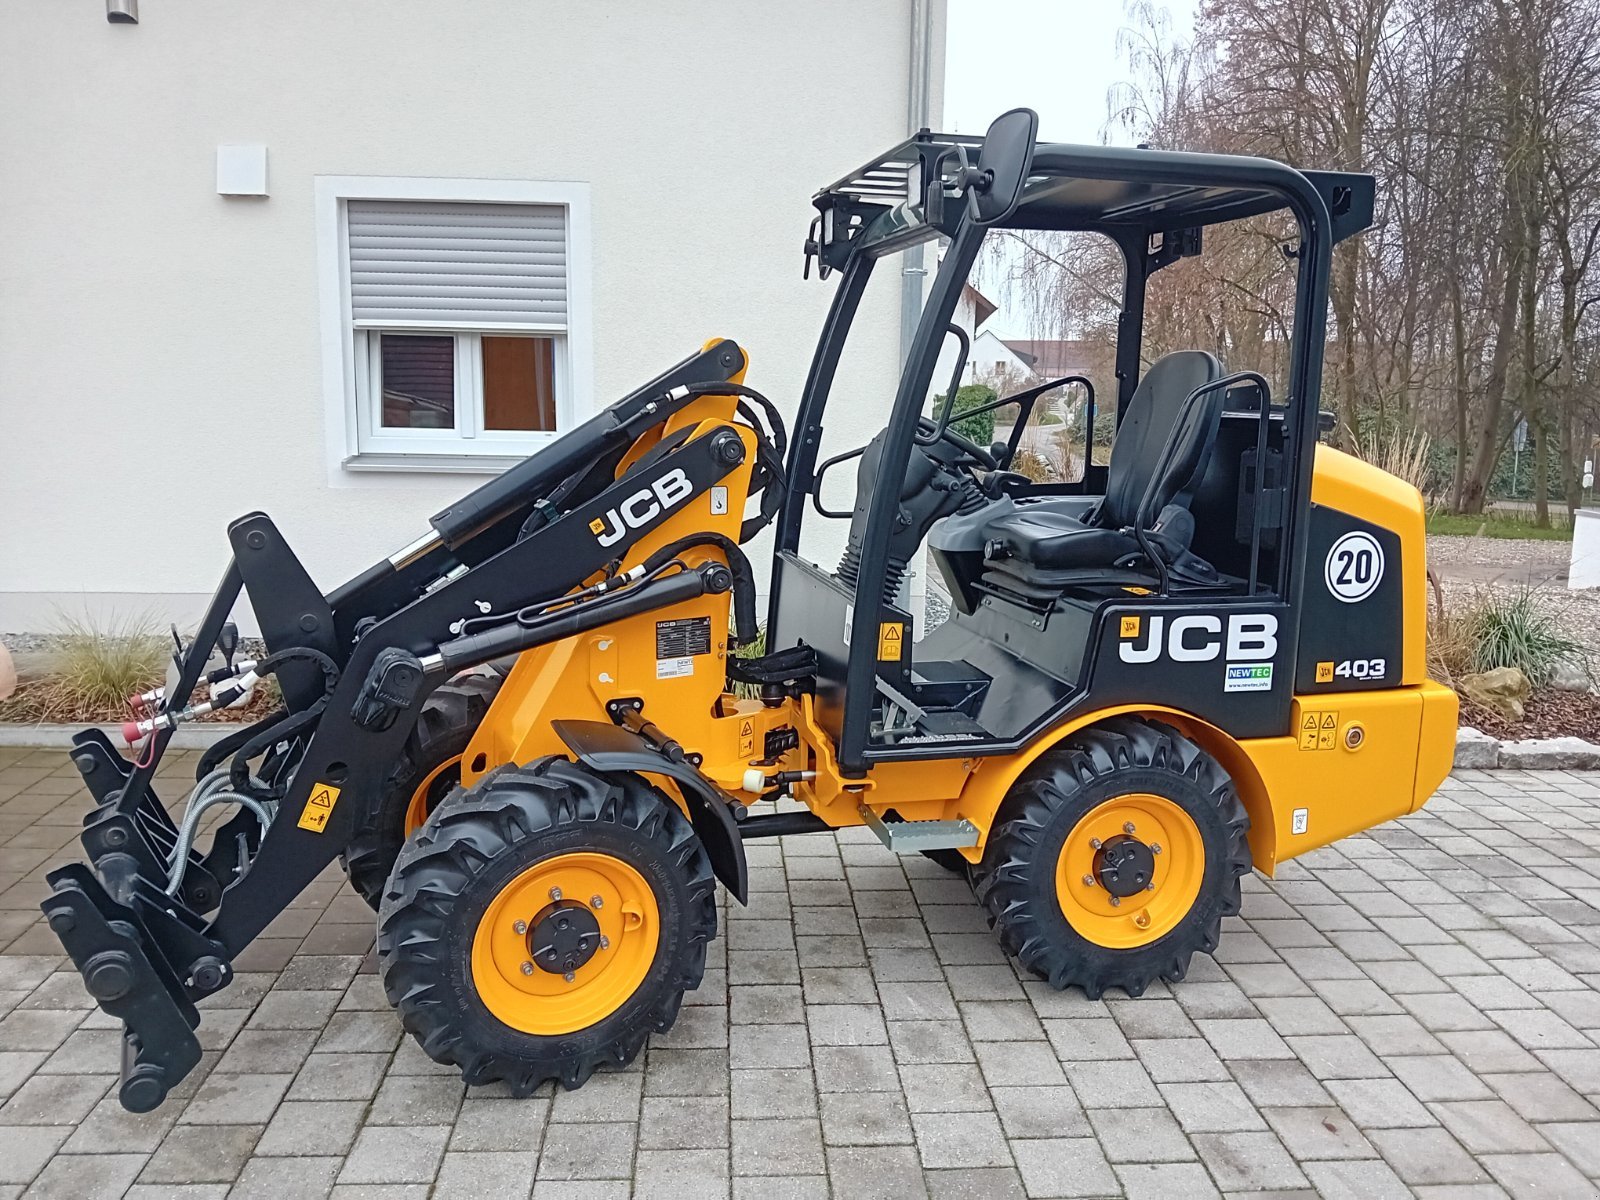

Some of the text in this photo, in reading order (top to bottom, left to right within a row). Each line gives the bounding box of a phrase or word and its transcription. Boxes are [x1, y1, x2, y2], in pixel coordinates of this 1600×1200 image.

[597, 468, 693, 547] JCB
[1336, 549, 1373, 585] 20
[1119, 614, 1278, 663] JCB
[1229, 667, 1271, 679] NEWTEC
[1335, 658, 1386, 678] 403
